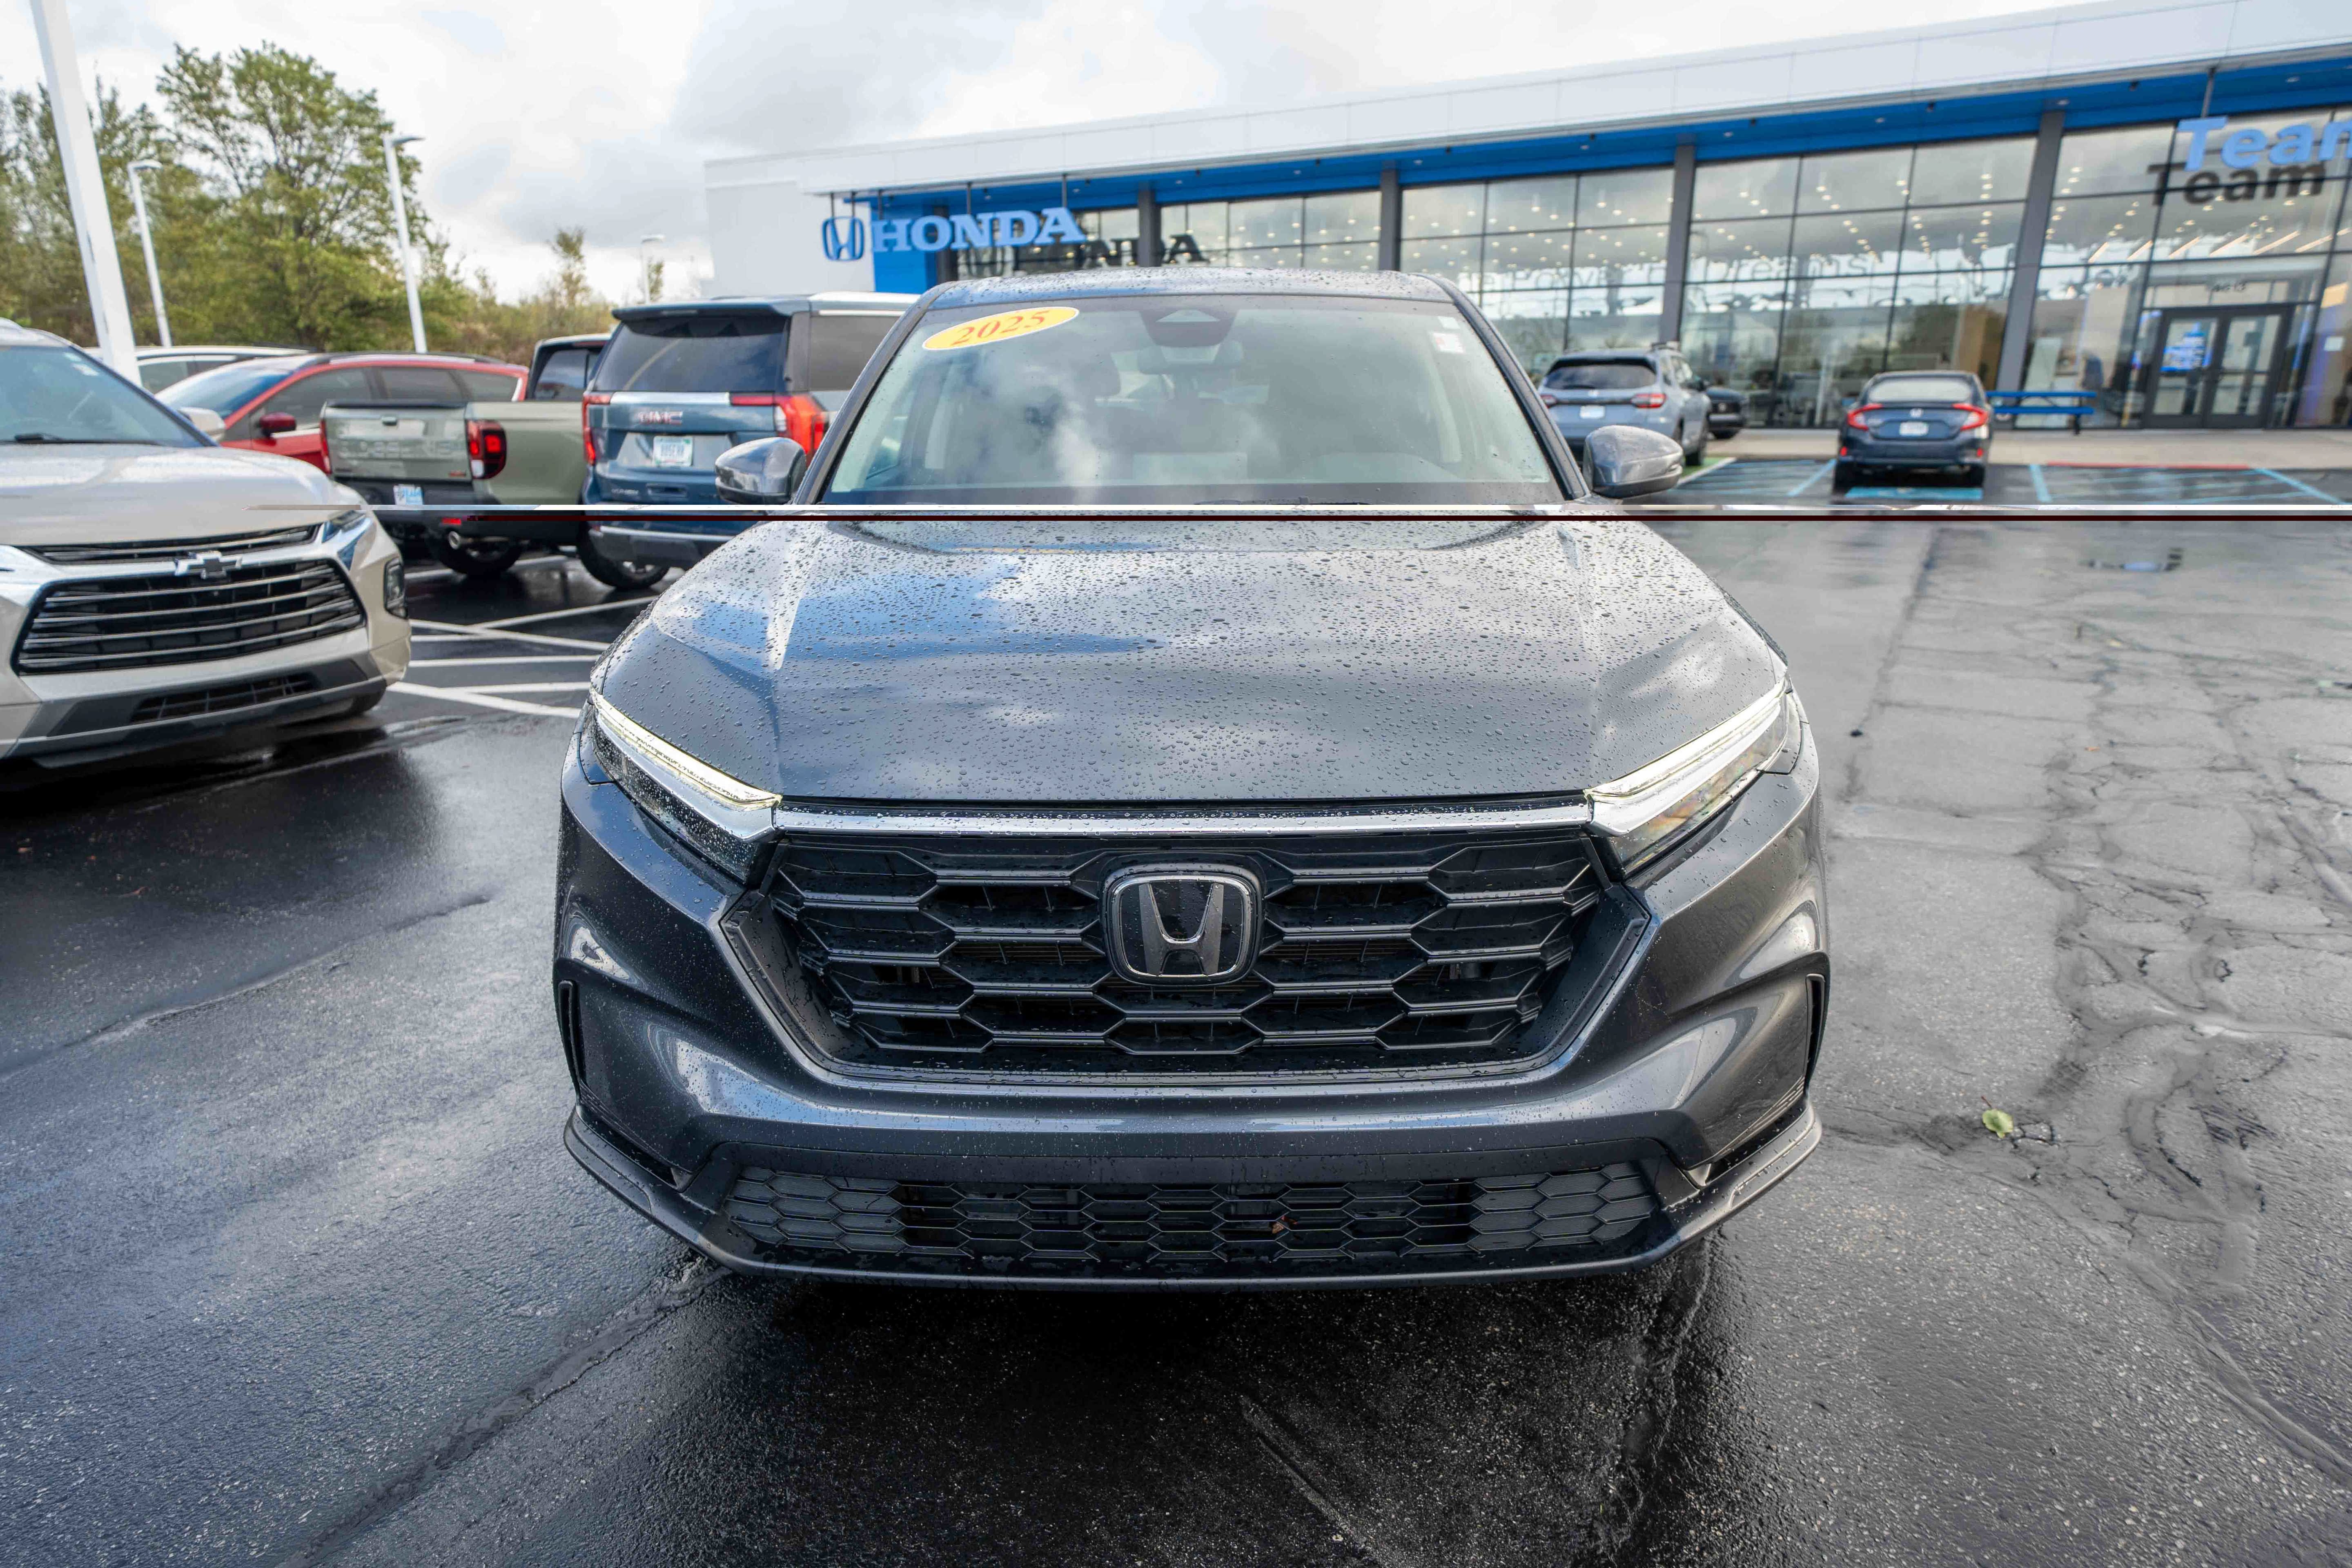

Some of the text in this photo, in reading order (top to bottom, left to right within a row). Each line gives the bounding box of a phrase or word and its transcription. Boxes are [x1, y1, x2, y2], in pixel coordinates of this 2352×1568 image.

[871, 207, 1086, 252] HONDA
[950, 310, 1050, 346] 2025
[637, 411, 683, 425] GMC
